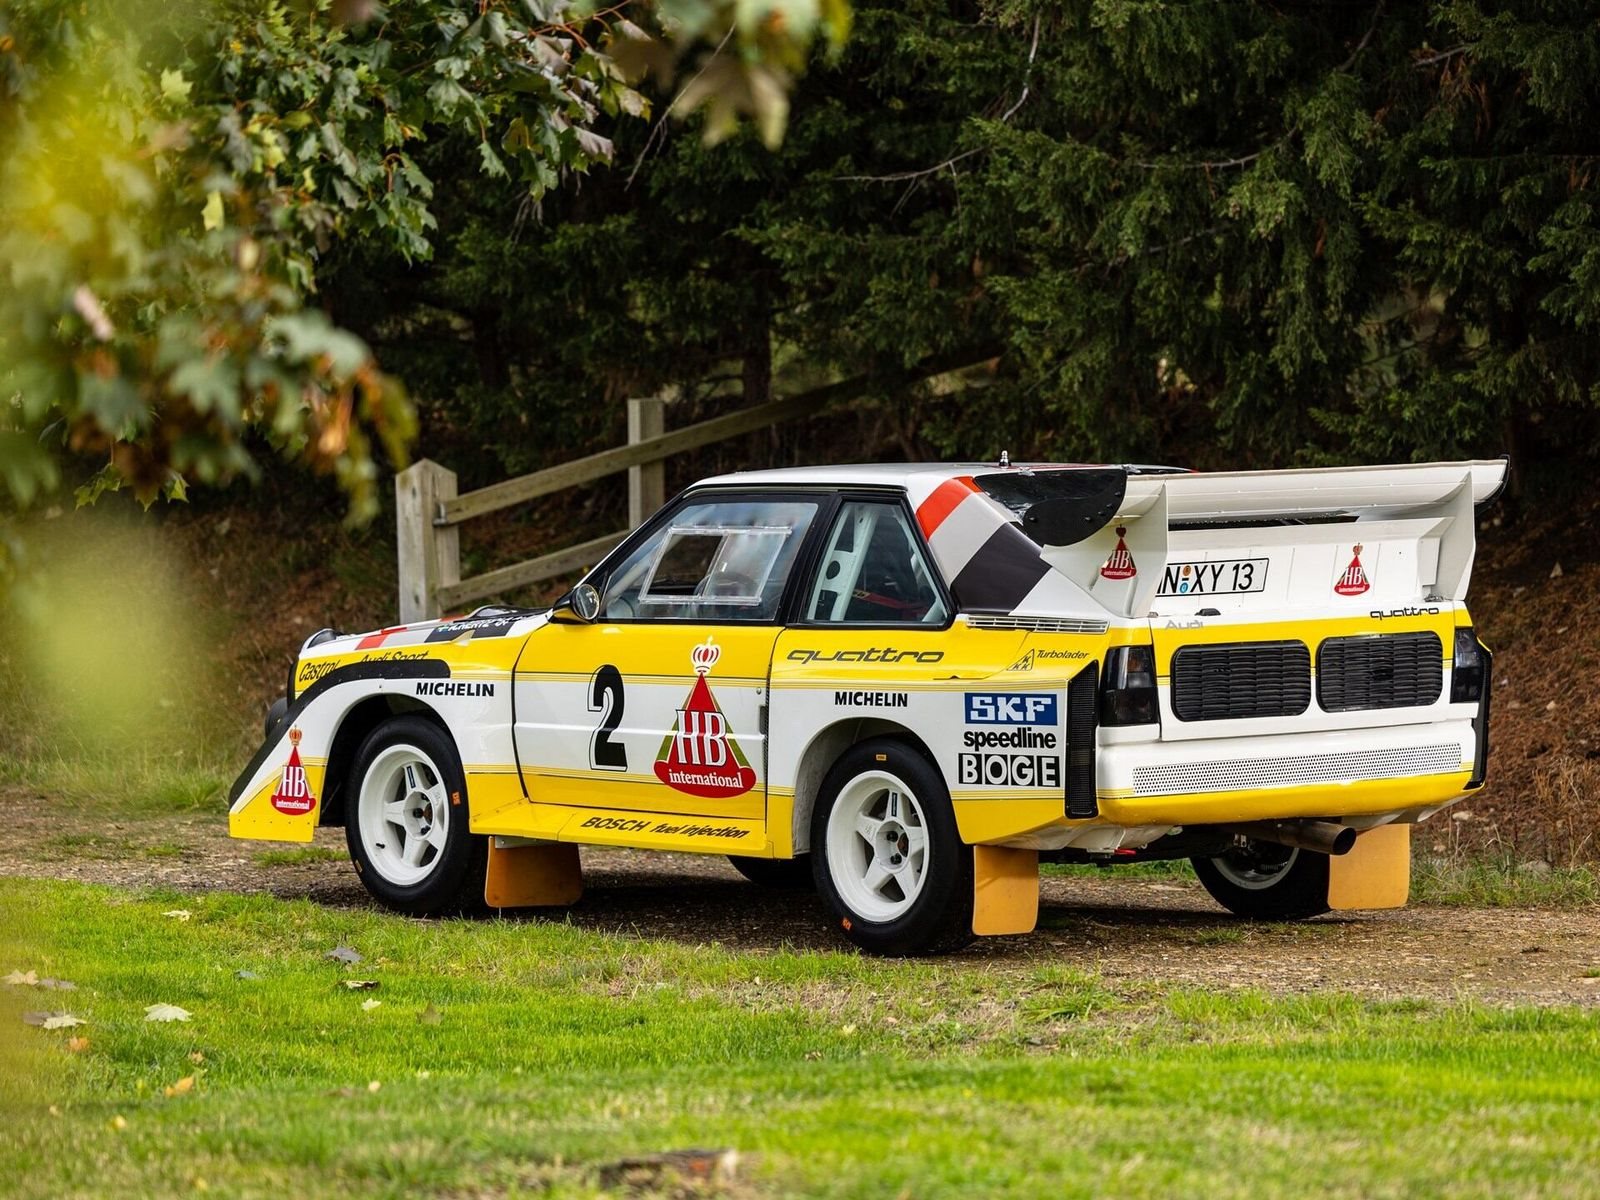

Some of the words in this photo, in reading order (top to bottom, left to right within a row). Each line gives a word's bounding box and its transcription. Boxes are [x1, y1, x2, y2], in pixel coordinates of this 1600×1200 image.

[1110, 550, 1130, 569] HB
[1232, 563, 1254, 591] 13
[1344, 566, 1363, 585] HB
[1370, 606, 1440, 620] quattro
[1165, 620, 1204, 630] Audi
[786, 647, 945, 665] quattro
[1037, 649, 1089, 659] Turbolader
[415, 682, 495, 697] MICHELIN
[834, 691, 908, 707] MICHELIN
[587, 664, 628, 772] 2
[969, 696, 1052, 722] SKF
[676, 709, 727, 767] HB
[963, 727, 1057, 751] speedline
[668, 769, 744, 788] international
[961, 753, 1058, 787] BOGE
[282, 766, 306, 797] HB
[580, 816, 652, 832] BOSCH
[650, 823, 688, 835] fuel
[680, 824, 750, 839] injection
